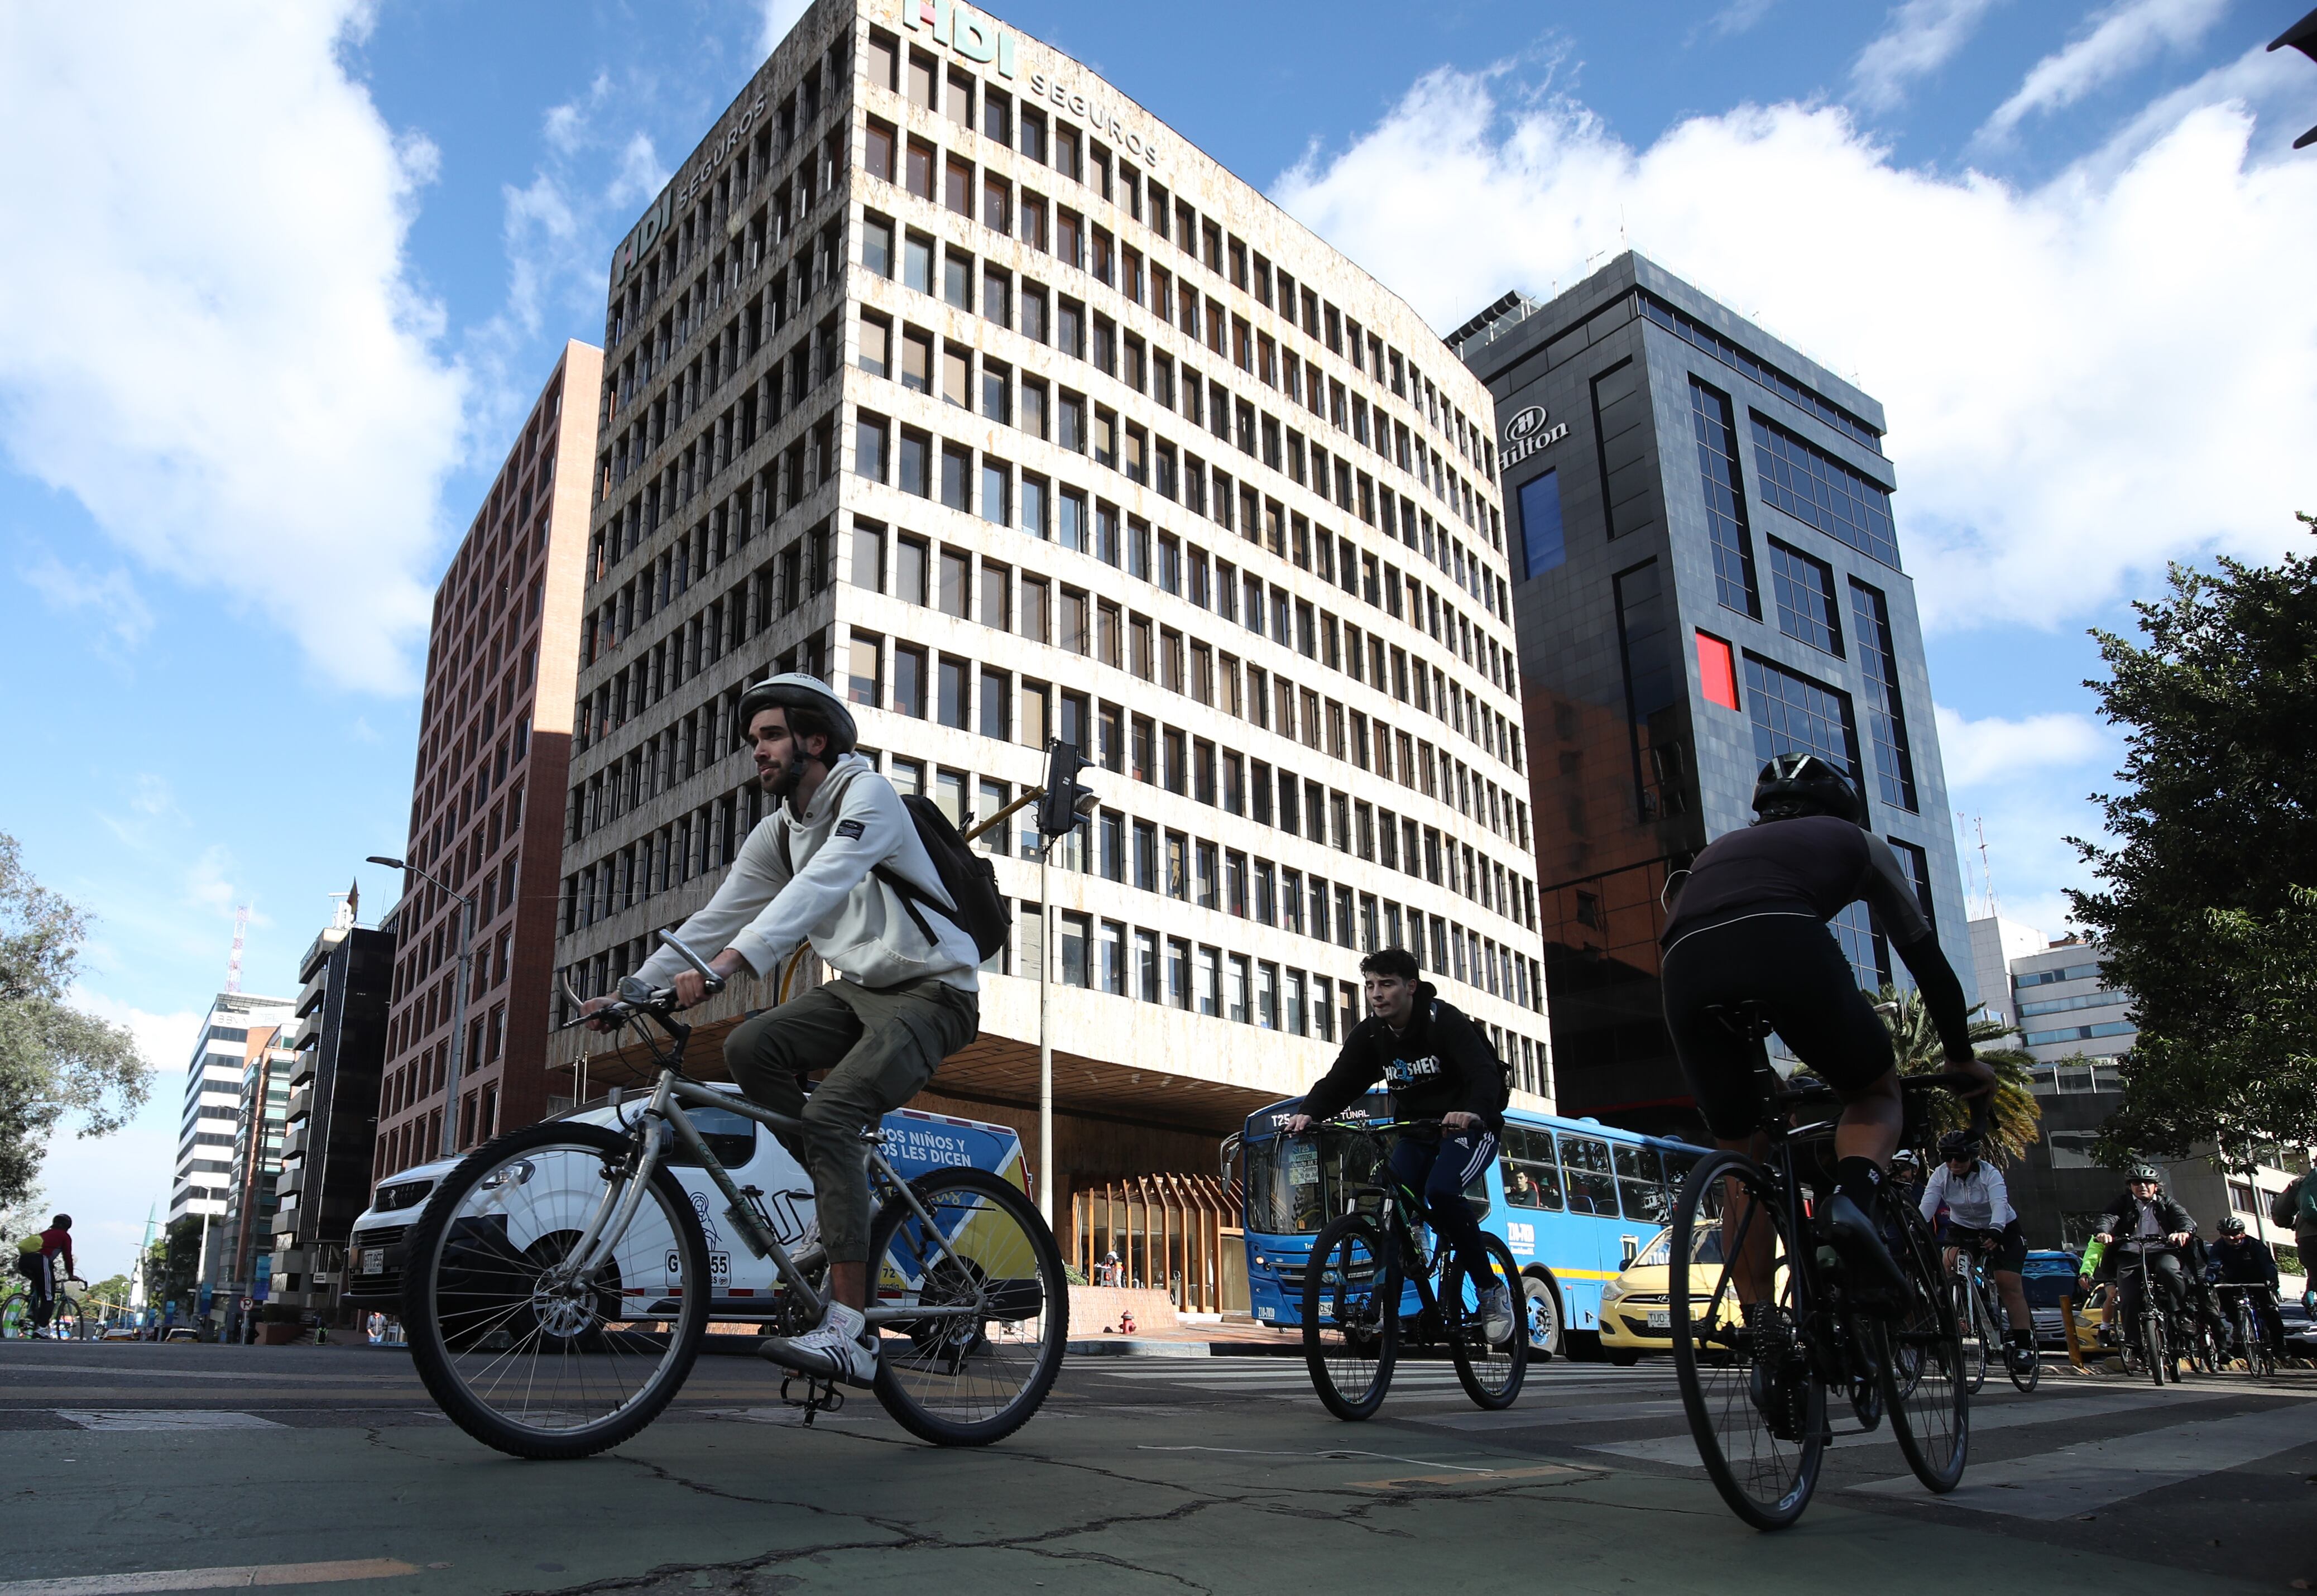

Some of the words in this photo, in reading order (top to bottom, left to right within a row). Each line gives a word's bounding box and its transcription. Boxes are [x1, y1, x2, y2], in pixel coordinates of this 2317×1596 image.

[903, 0, 1014, 80] HDI
[1030, 71, 1158, 167] SEGUROS
[617, 187, 674, 287] HDI
[678, 93, 767, 210] SEGUROS
[1499, 422, 1568, 472] Hilton
[1271, 1113, 1290, 1127] T25
[1340, 1109, 1370, 1120] TUNAL
[909, 1130, 954, 1151] NIÑOS
[956, 1138, 965, 1152] Y
[1298, 1144, 1310, 1153] T25
[901, 1144, 927, 1161] LES
[930, 1149, 972, 1167] DICEN
[698, 1143, 766, 1229] GIANT
